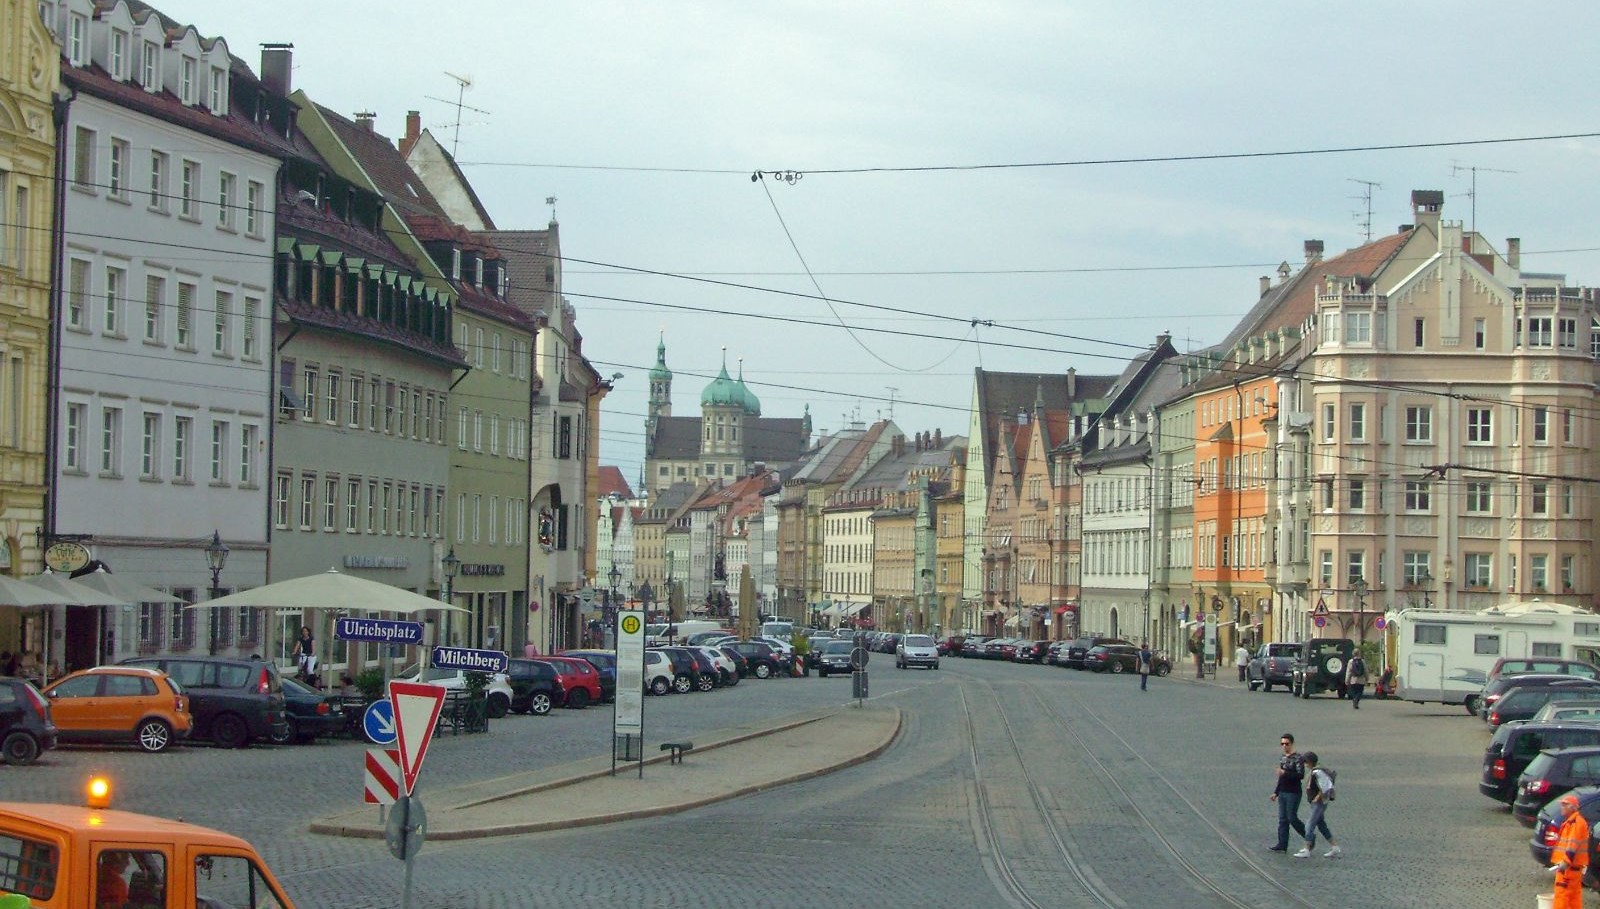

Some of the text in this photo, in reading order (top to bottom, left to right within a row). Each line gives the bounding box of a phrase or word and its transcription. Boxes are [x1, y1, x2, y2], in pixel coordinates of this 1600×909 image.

[344, 621, 416, 640] Ulrichsplatz
[626, 618, 636, 630] H
[439, 650, 501, 671] Milchberg
